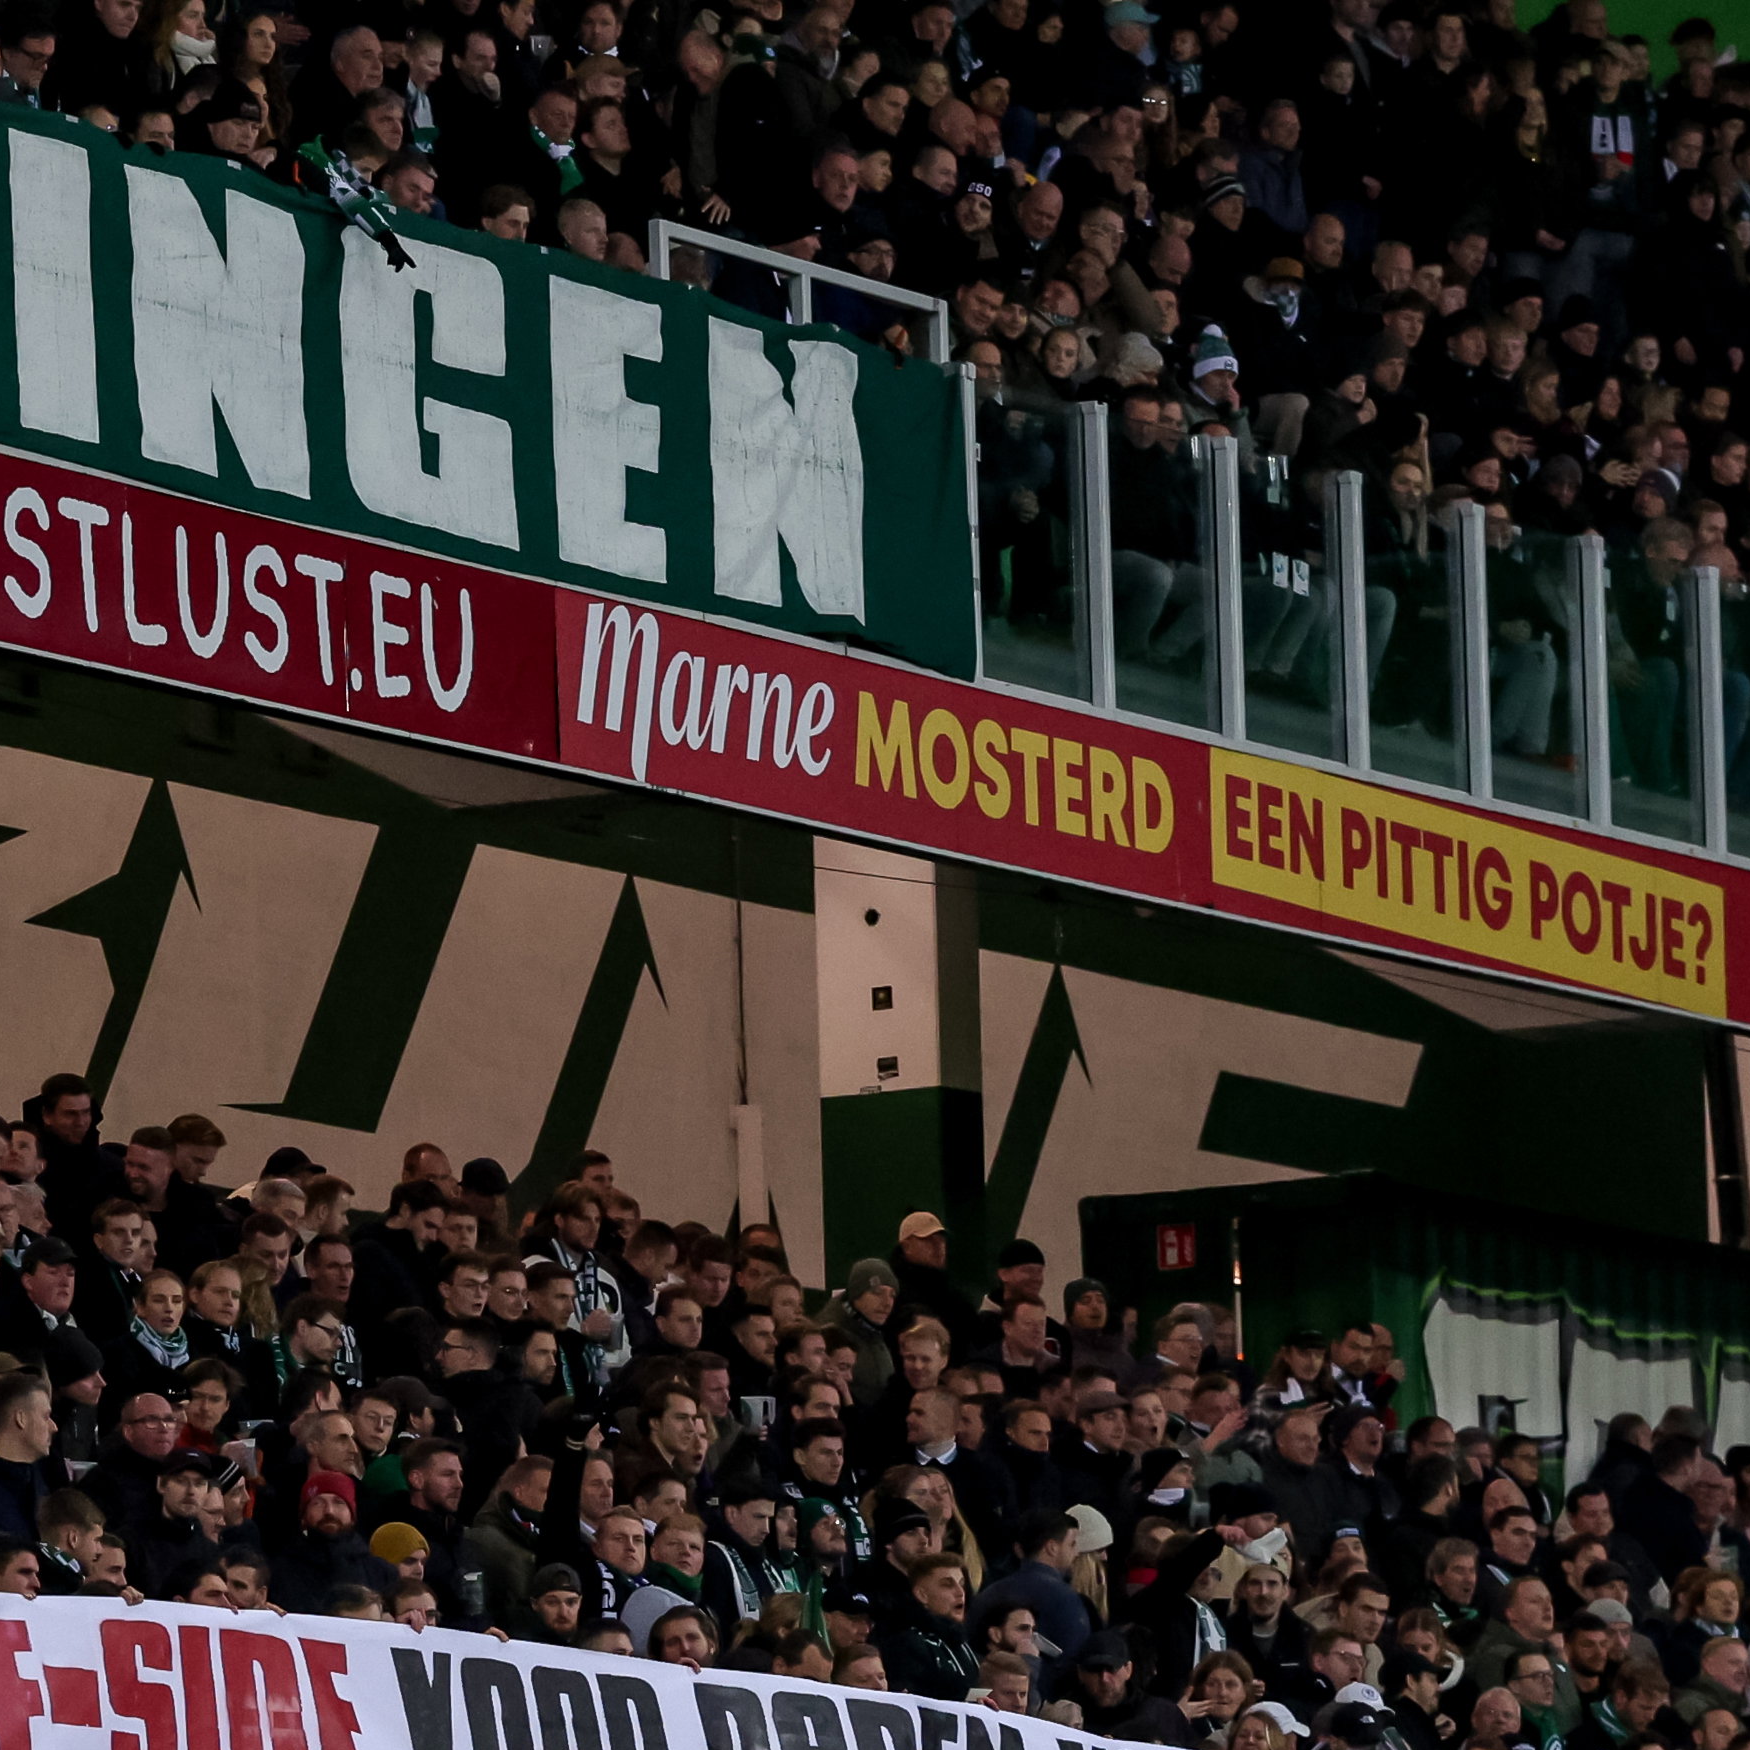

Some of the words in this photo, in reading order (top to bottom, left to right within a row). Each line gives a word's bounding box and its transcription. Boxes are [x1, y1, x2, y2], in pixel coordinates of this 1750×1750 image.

[576, 602, 836, 784] Marne
[854, 691, 1176, 856] MOSTERD
[1225, 774, 1330, 873] EEN
[1340, 800, 1514, 932] PITTIG
[1529, 858, 1714, 987] POTJE?
